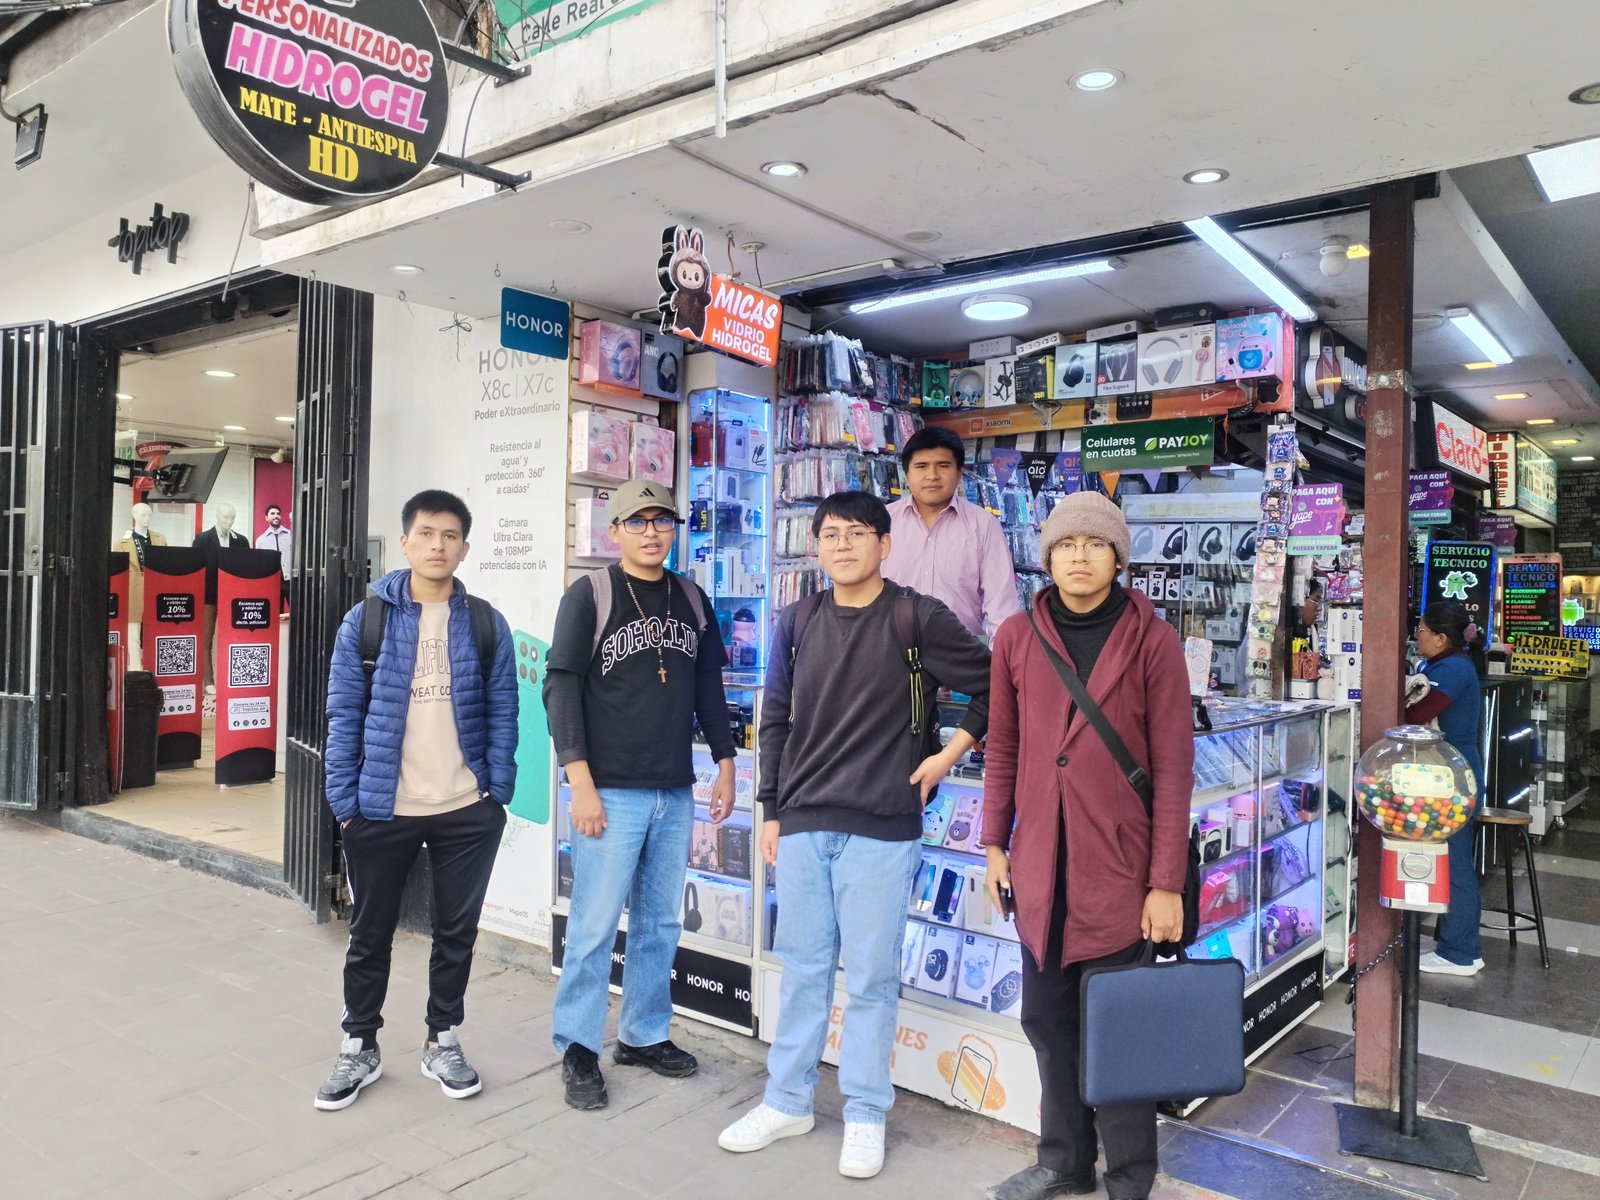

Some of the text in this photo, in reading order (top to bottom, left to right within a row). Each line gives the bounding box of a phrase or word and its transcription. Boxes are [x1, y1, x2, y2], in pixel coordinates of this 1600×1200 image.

[523, 1, 604, 44] Calle Real
[222, 0, 430, 78] ERSONALIZADOS
[227, 25, 427, 132] HIDROGEL
[240, 86, 417, 163] MATE - ANTIESPIA
[308, 135, 359, 182] HD
[714, 282, 778, 329] MICAS
[506, 311, 563, 338] HONOR
[724, 317, 765, 343] VIDRIO
[644, 345, 659, 357] ANC
[712, 328, 771, 362] HIDROGEL
[481, 379, 510, 402] X8c
[523, 372, 554, 396] X7c
[474, 400, 560, 420] Poder eXtraordinario
[985, 418, 1011, 428] xiaomi
[490, 439, 541, 453] Resistencia al
[1086, 437, 1135, 448] Celulares
[1159, 434, 1208, 448] PAYJOY
[1436, 422, 1482, 474] Claro
[1086, 447, 1137, 459] en cuotas
[523, 456, 529, 467] y
[485, 469, 524, 483] protección
[1429, 472, 1448, 480] AQUÍ
[1292, 485, 1338, 496] PAGA AQUÍ
[1409, 491, 1428, 505] yape
[499, 517, 528, 527] Cámara
[1289, 511, 1313, 529] yape
[493, 532, 533, 542] Ultra Clara
[494, 547, 503, 556] de
[1432, 546, 1490, 556] SERVICIO
[480, 560, 547, 572] potenciada con IA
[1433, 559, 1488, 568] TECNICO
[1508, 573, 1555, 582] TECNICO
[243, 612, 262, 620] 10%
[1512, 648, 1558, 657] CAMBIO
[687, 974, 724, 994] HONOR
[1258, 1001, 1277, 1022] HONOR
[1281, 985, 1298, 1005] HONOR
[1301, 971, 1317, 990] HONOR
